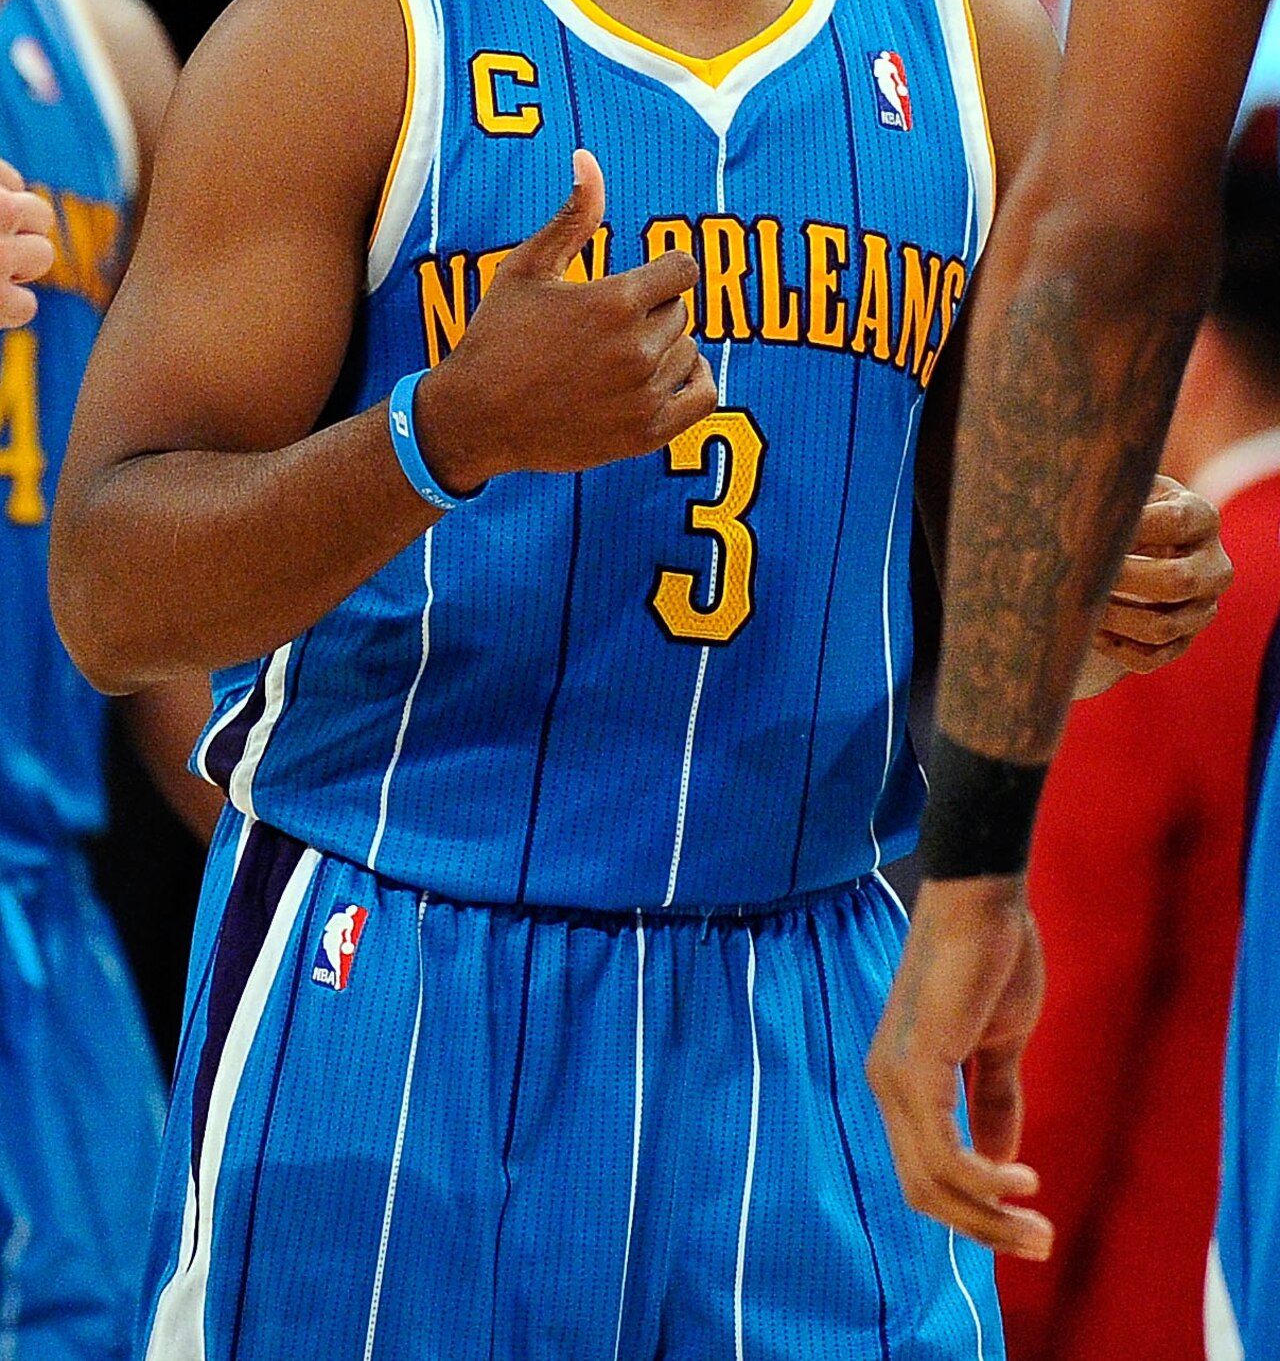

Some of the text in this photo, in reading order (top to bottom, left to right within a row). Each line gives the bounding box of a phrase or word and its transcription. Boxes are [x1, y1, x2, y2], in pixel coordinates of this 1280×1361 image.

[472, 51, 540, 135] C
[881, 110, 903, 127] NBA
[652, 410, 764, 642] 3
[312, 966, 336, 986] NBA
